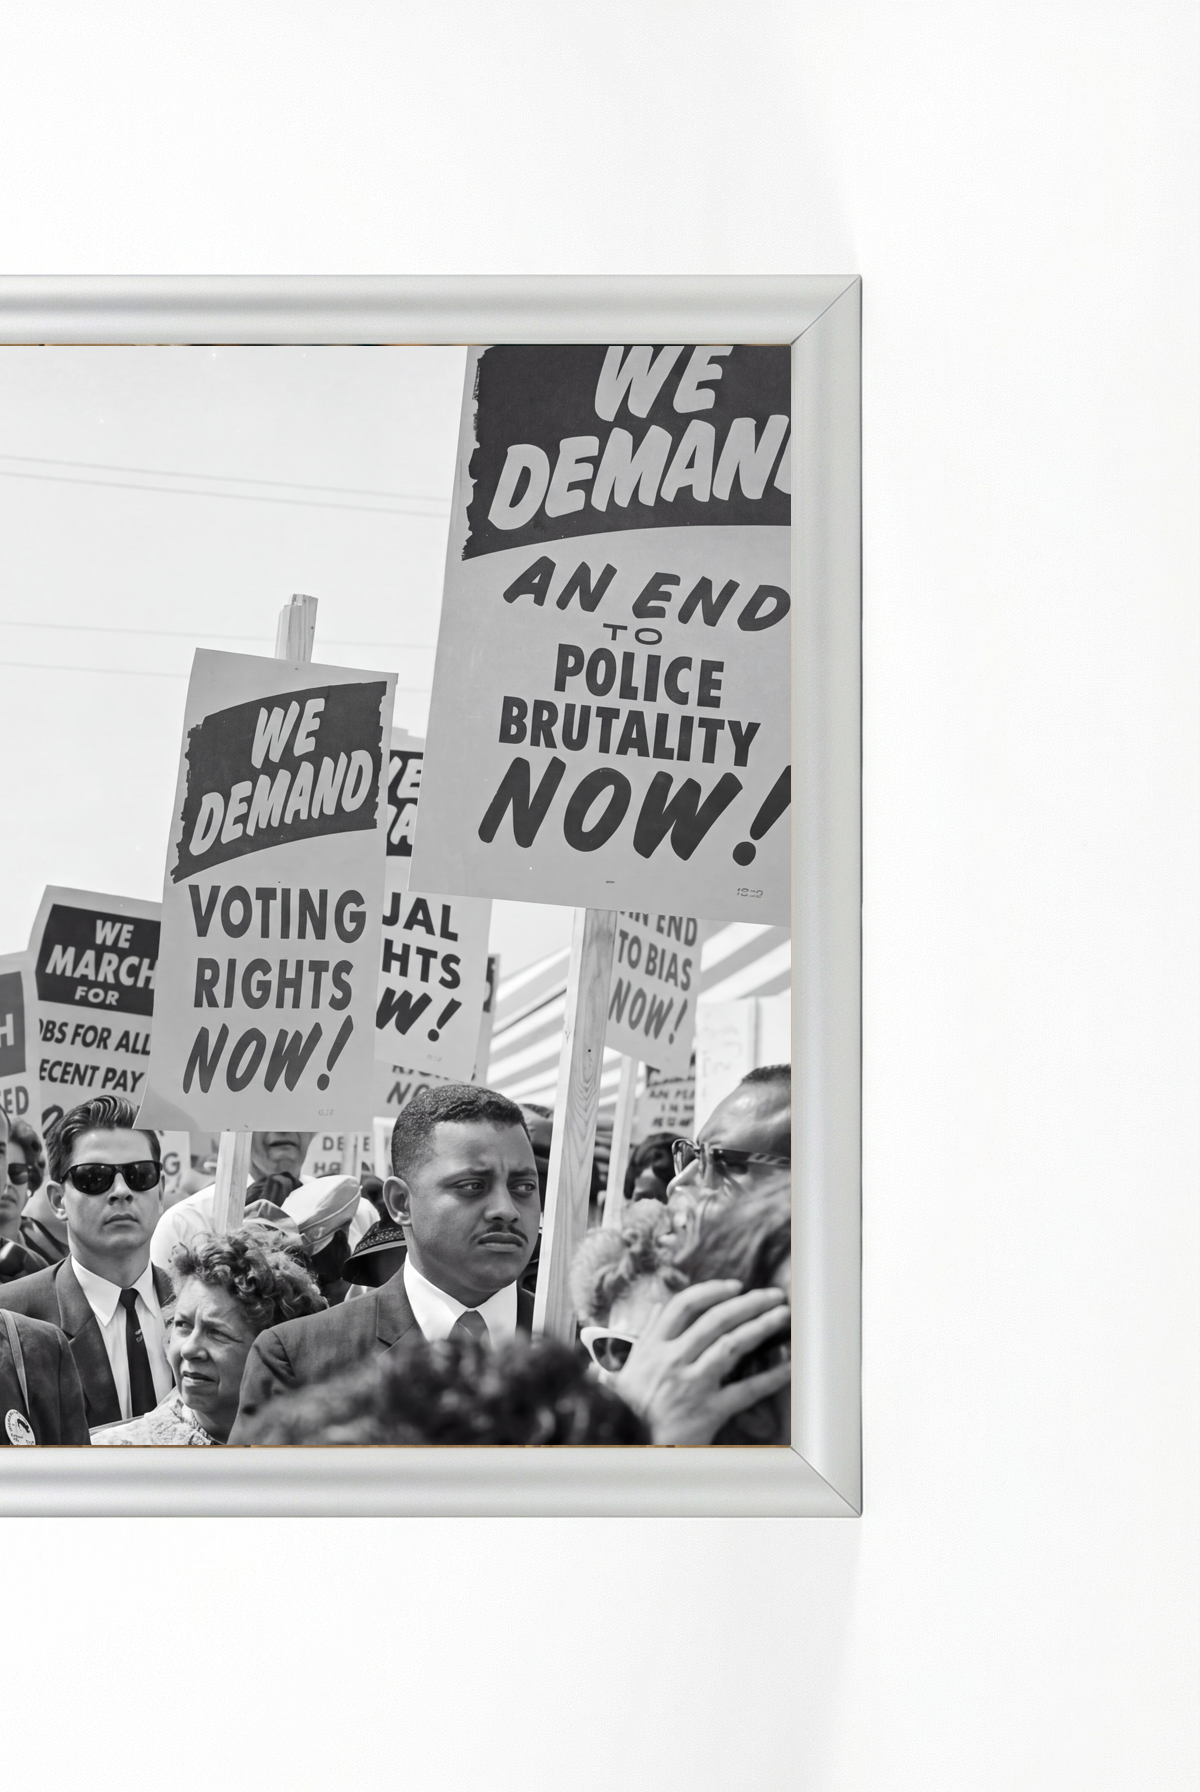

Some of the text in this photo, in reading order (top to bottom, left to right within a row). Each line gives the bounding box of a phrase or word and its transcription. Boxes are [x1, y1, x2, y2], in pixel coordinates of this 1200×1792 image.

[595, 346, 733, 422] WE
[487, 414, 791, 530] DEMAN
[502, 556, 791, 632] AN END
[602, 623, 663, 645] TO
[554, 643, 725, 709] POLICE
[251, 698, 326, 769] WE
[499, 695, 762, 768] BRUTALITY
[189, 750, 374, 857] DEMAND
[477, 755, 791, 867] NOW!
[95, 919, 135, 949] WE
[188, 883, 367, 944] VOTING
[656, 915, 698, 947] END
[45, 944, 158, 990] MARCH
[193, 957, 354, 1011] RIGHTS
[618, 928, 693, 992] TO BIAS
[74, 985, 120, 1006] FOR
[608, 977, 688, 1046] NOW!
[70, 1023, 112, 1050] FOR
[114, 1030, 151, 1056] ALL
[182, 1015, 355, 1095] NOW!
[39, 1058, 145, 1093] ECENT PAY
